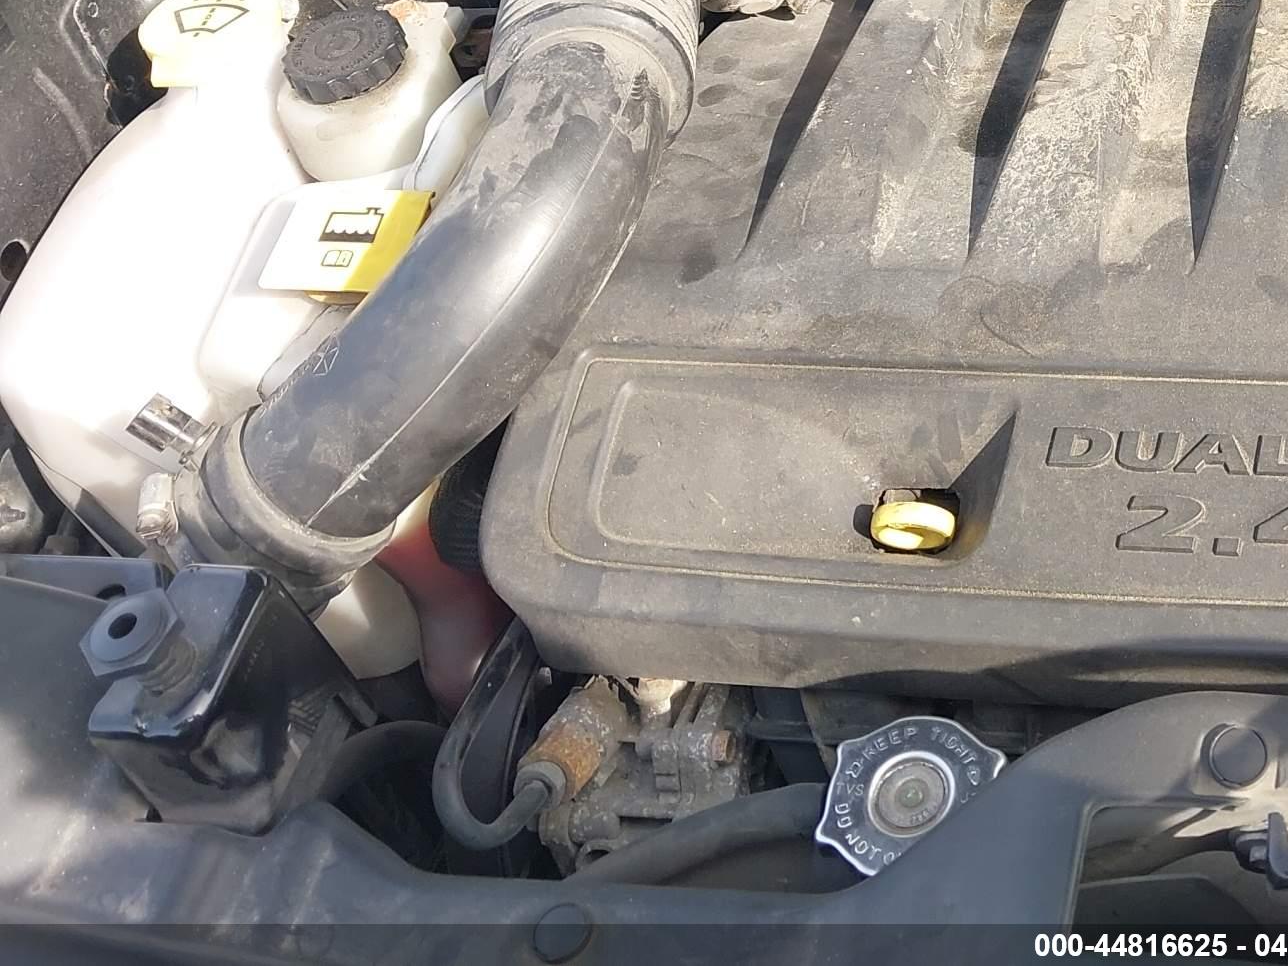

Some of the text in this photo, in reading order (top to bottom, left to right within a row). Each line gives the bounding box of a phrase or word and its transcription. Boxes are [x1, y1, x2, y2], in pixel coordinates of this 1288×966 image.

[863, 726, 978, 766] KEEP TIGHT
[836, 781, 865, 796] TVS
[835, 803, 882, 861] DO NOT
